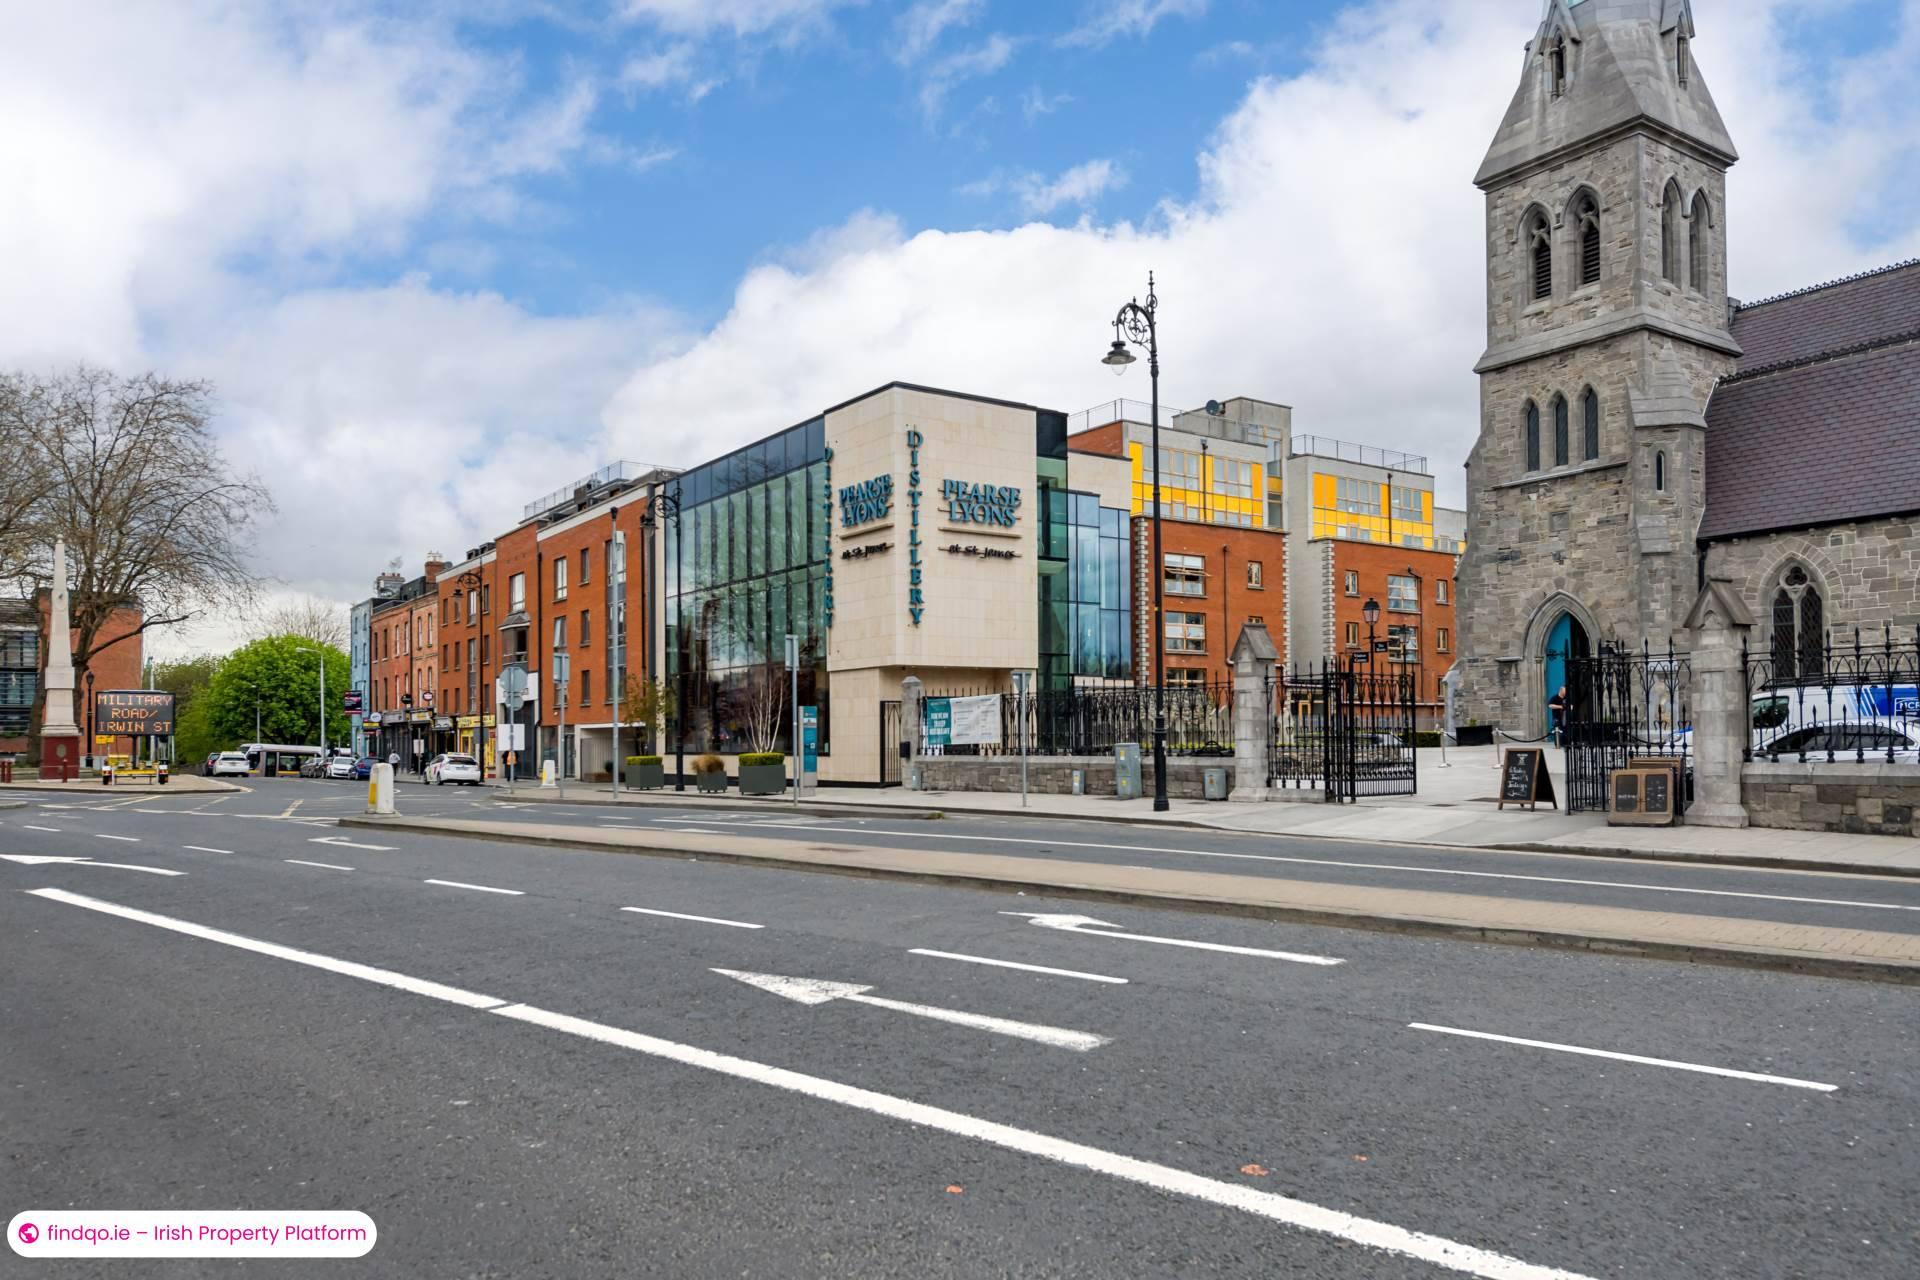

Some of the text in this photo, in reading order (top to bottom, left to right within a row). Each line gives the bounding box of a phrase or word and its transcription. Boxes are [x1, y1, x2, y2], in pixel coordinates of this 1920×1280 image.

[838, 473, 892, 508] PEARSE
[943, 479, 1021, 508] PEARSE
[841, 496, 889, 528] LYONS
[949, 501, 1016, 528] LYONS
[907, 430, 924, 624] DISTILLERY
[97, 695, 172, 705] MILITARY
[112, 708, 158, 718] ROAD/
[99, 721, 171, 732] IRWIN ST
